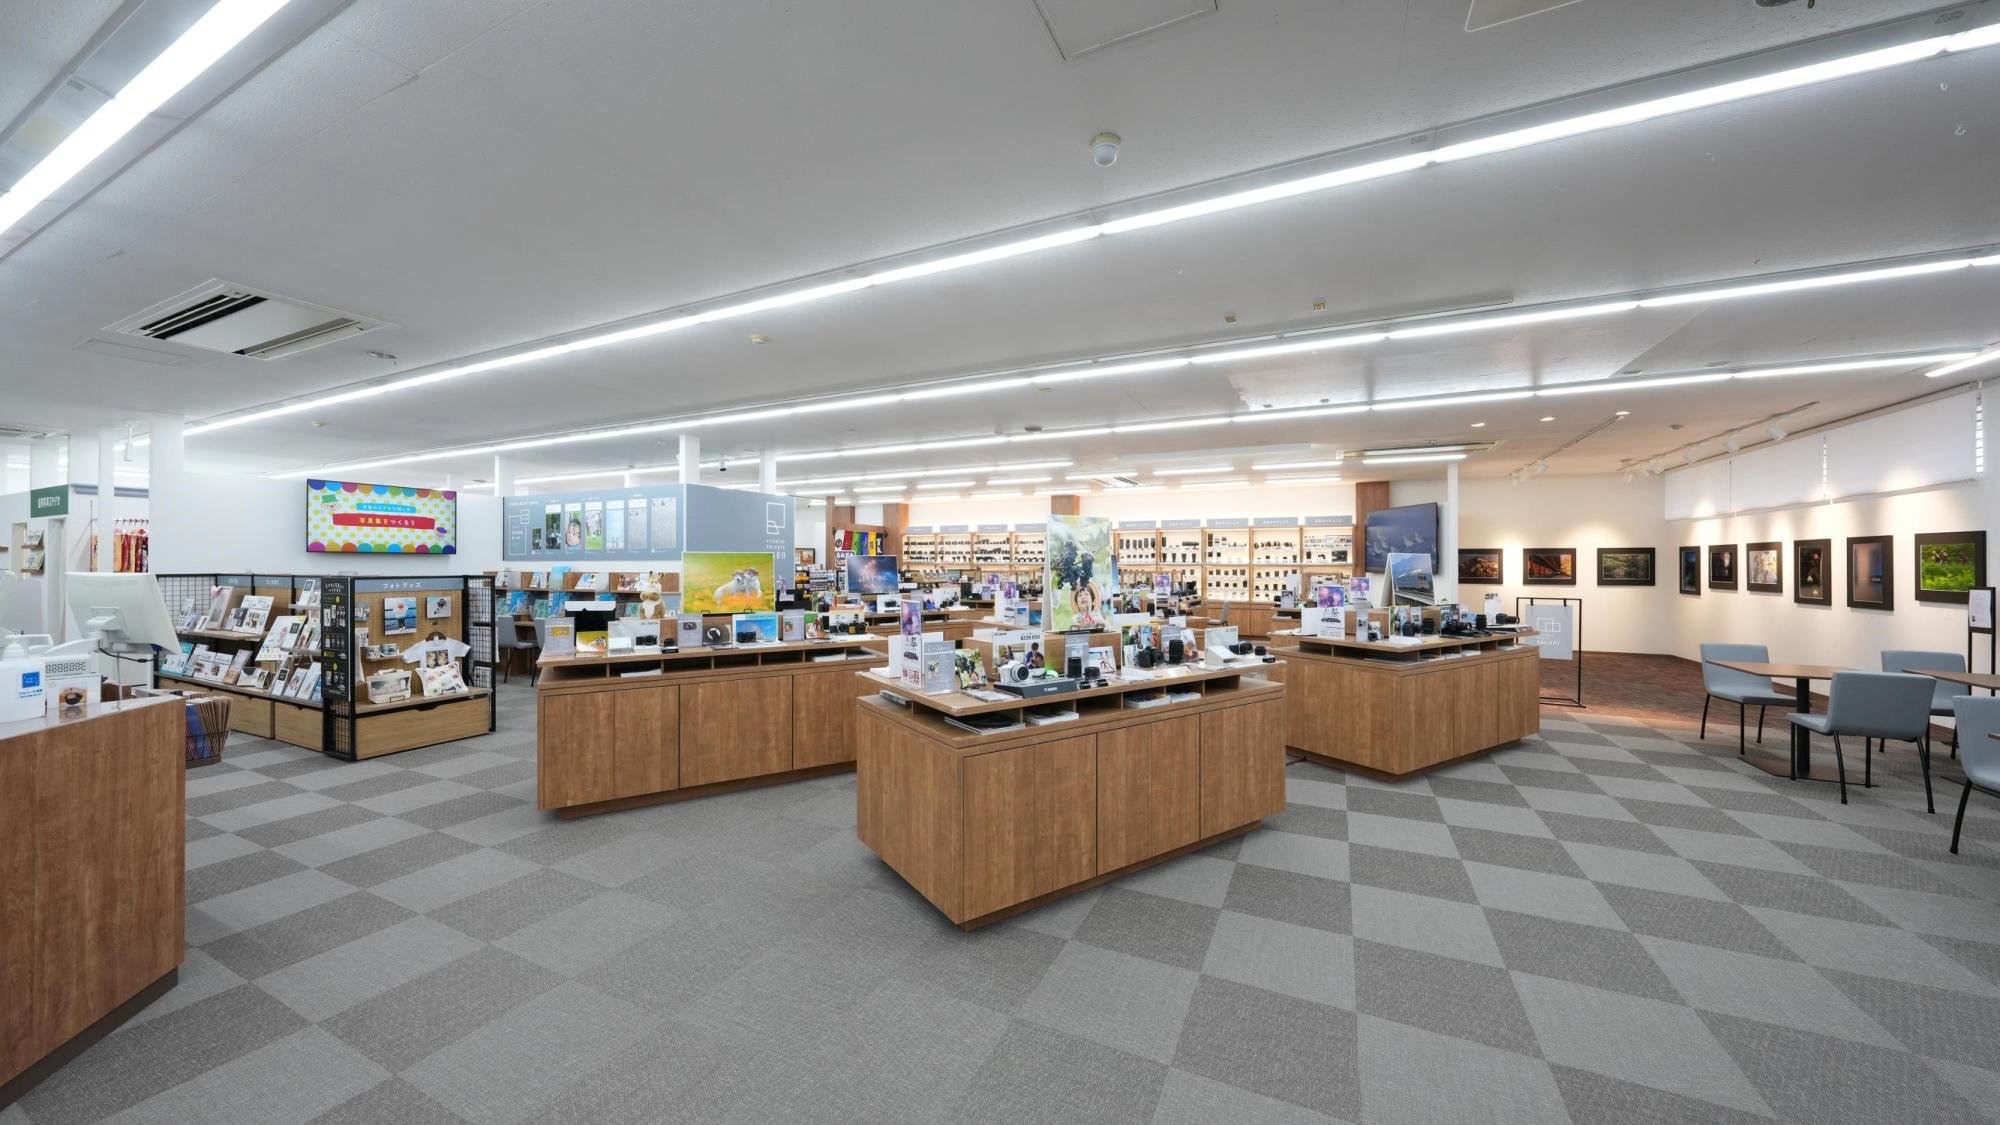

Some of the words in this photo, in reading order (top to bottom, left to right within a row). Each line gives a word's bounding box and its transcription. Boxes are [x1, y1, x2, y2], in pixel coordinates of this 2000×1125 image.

[360, 517, 415, 527] 写真集をつくろう
[383, 581, 422, 590] フォトグッズ
